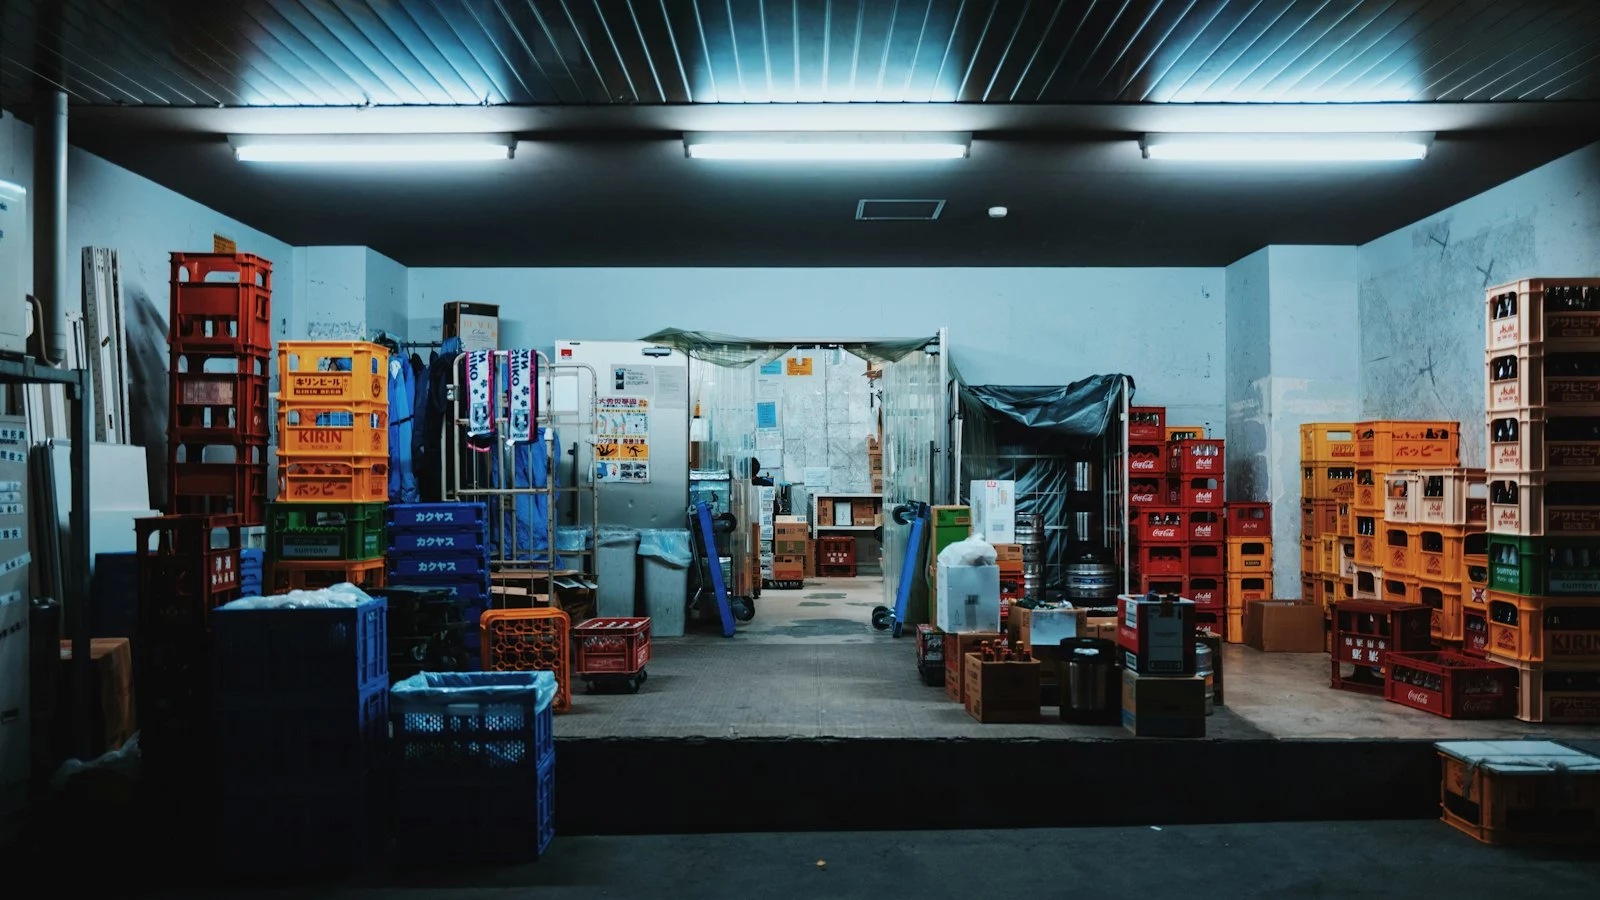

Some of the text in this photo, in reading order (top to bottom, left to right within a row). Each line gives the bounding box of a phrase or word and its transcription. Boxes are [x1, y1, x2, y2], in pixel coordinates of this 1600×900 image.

[296, 378, 340, 386] キリンビール
[299, 430, 342, 443] KIRIN
[1396, 445, 1443, 457] ホッピー
[1132, 460, 1153, 469] Coca-Cola
[295, 481, 347, 496] ホッピー
[1132, 494, 1153, 502] Coca-Cola
[416, 512, 453, 522] カクヤス
[1153, 528, 1175, 537] Coca-Cola
[417, 537, 455, 547] カクヤス
[419, 562, 456, 572] カクヤス
[1497, 567, 1519, 577] SUNTORY
[1407, 690, 1428, 704] Coca-Cola
